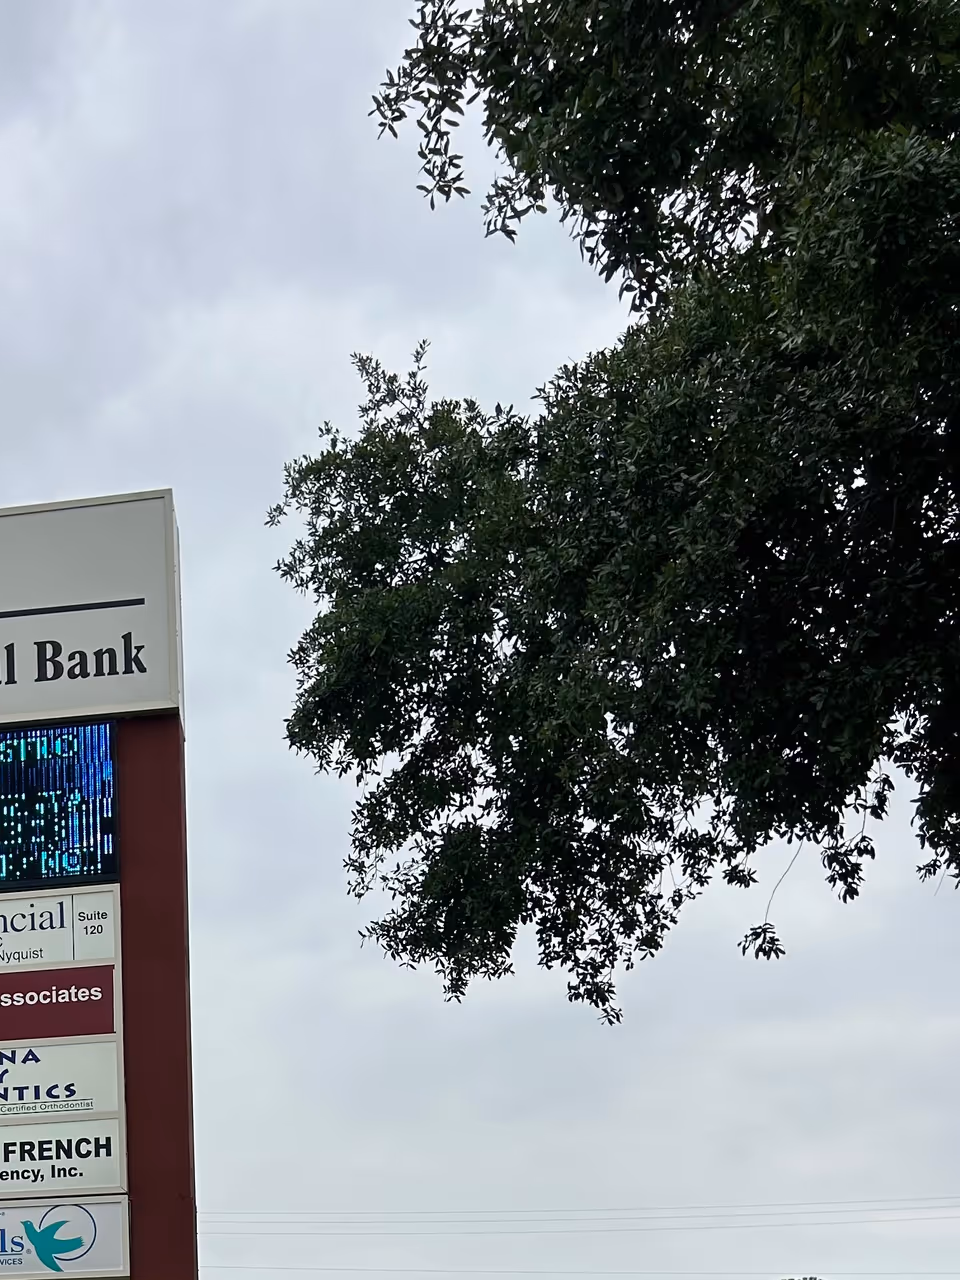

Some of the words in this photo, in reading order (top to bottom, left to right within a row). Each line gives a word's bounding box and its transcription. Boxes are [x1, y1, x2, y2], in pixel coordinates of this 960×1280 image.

[34, 631, 147, 682] Bank
[78, 910, 108, 922] Suite
[84, 924, 104, 935] 120
[40, 1100, 94, 1111] Orthodontist
[3, 1136, 112, 1163] FRENCH
[51, 1164, 84, 1179] Inc.
